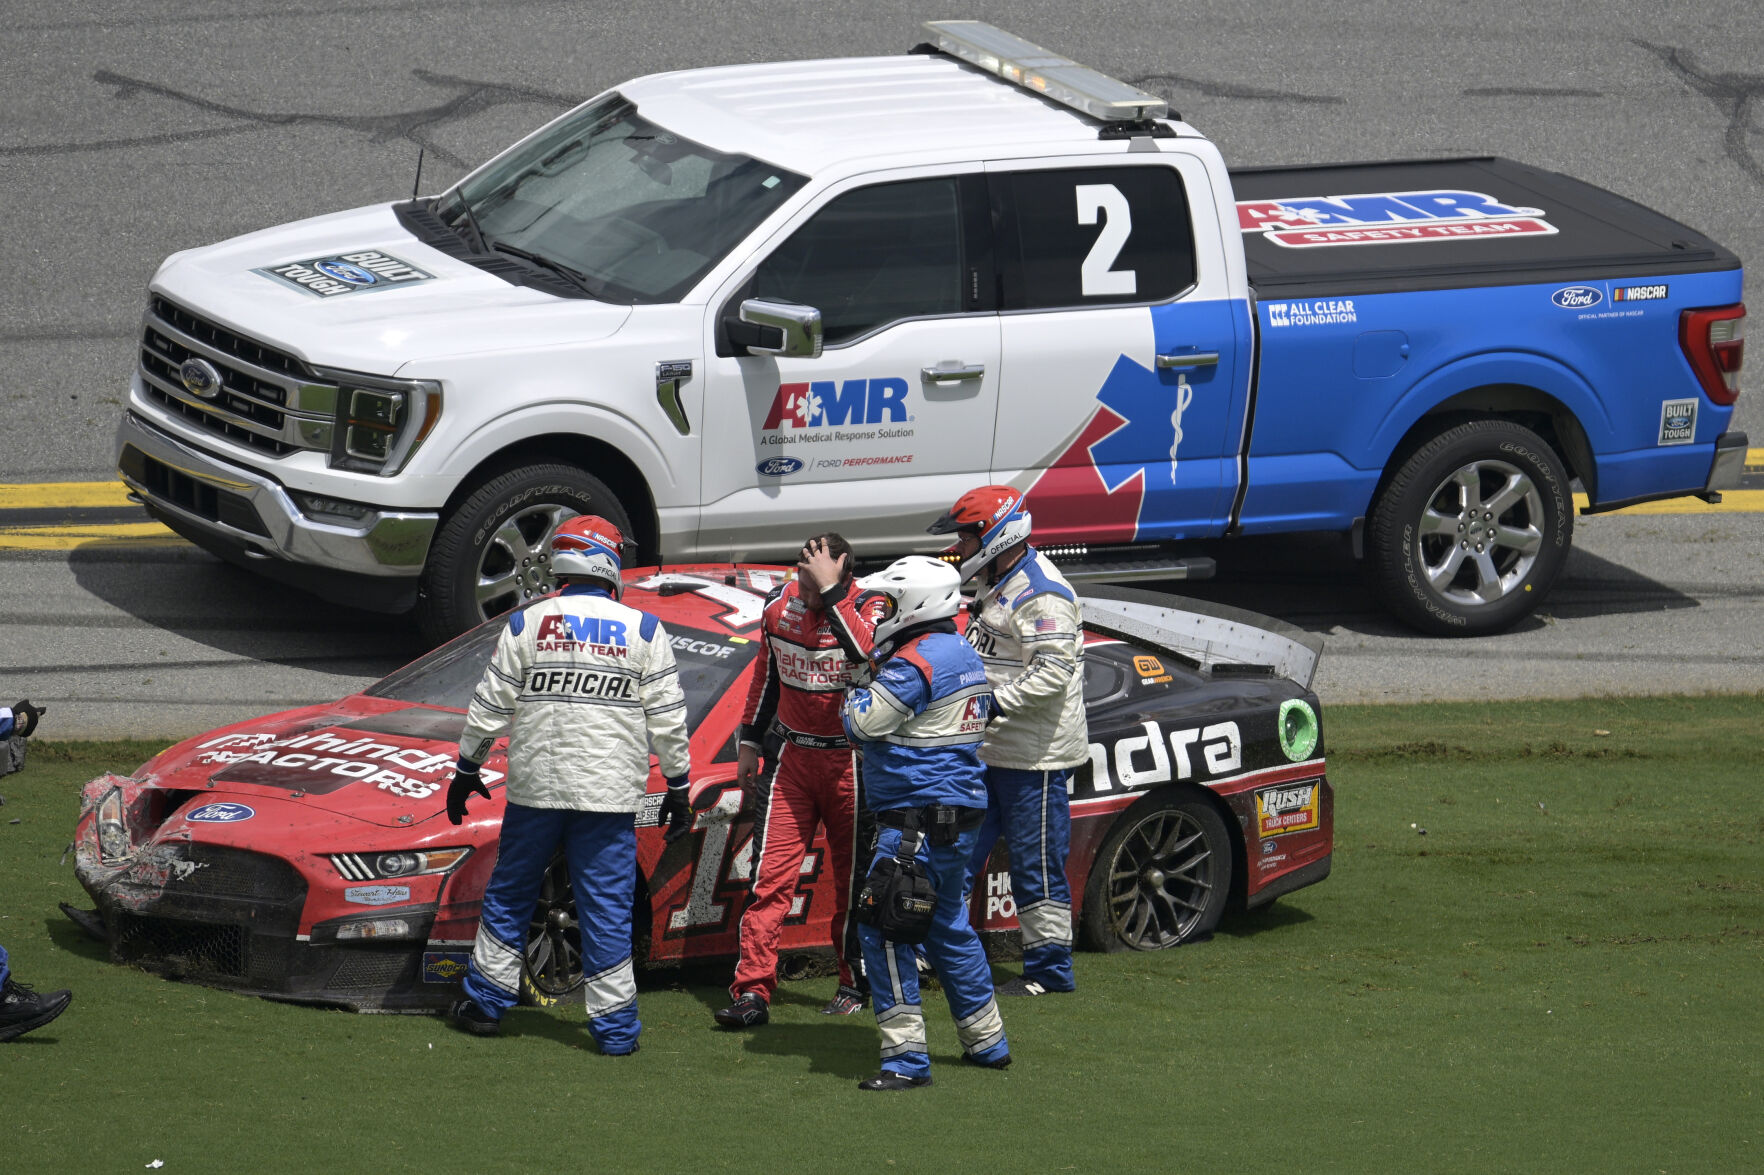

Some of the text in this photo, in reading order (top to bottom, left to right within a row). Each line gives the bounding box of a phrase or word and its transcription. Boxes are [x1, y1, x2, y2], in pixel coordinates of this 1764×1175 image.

[1235, 192, 1521, 231] AMR
[1076, 184, 1137, 296] 2
[1302, 222, 1523, 242] SAFETY TEAM
[341, 251, 429, 281] BUILT
[274, 263, 353, 296] TOUGH
[1561, 289, 1593, 306] Ford
[1627, 285, 1666, 300] NASCAR
[1290, 300, 1355, 315] ALL CLEAR
[1290, 313, 1357, 326] FOUNDATION
[762, 377, 909, 431] AMR
[1666, 404, 1693, 418] BUILT
[760, 428, 914, 446] A Global Medical Response Solution
[1664, 428, 1691, 439] TOUGH
[765, 458, 794, 474] Ford
[817, 455, 914, 468] FORD PERFORMANCE
[994, 496, 1014, 520] NASCAR
[594, 531, 617, 550] NASCAR
[990, 532, 1024, 555] OFFICIAL
[537, 614, 627, 647] AMR
[536, 641, 627, 659] SAFETY TEAM
[530, 671, 632, 699] OFFICIAL
[194, 804, 242, 821] Ford
[1265, 812, 1308, 829] TRUCK CENTERS
[986, 894, 1017, 920] PO
